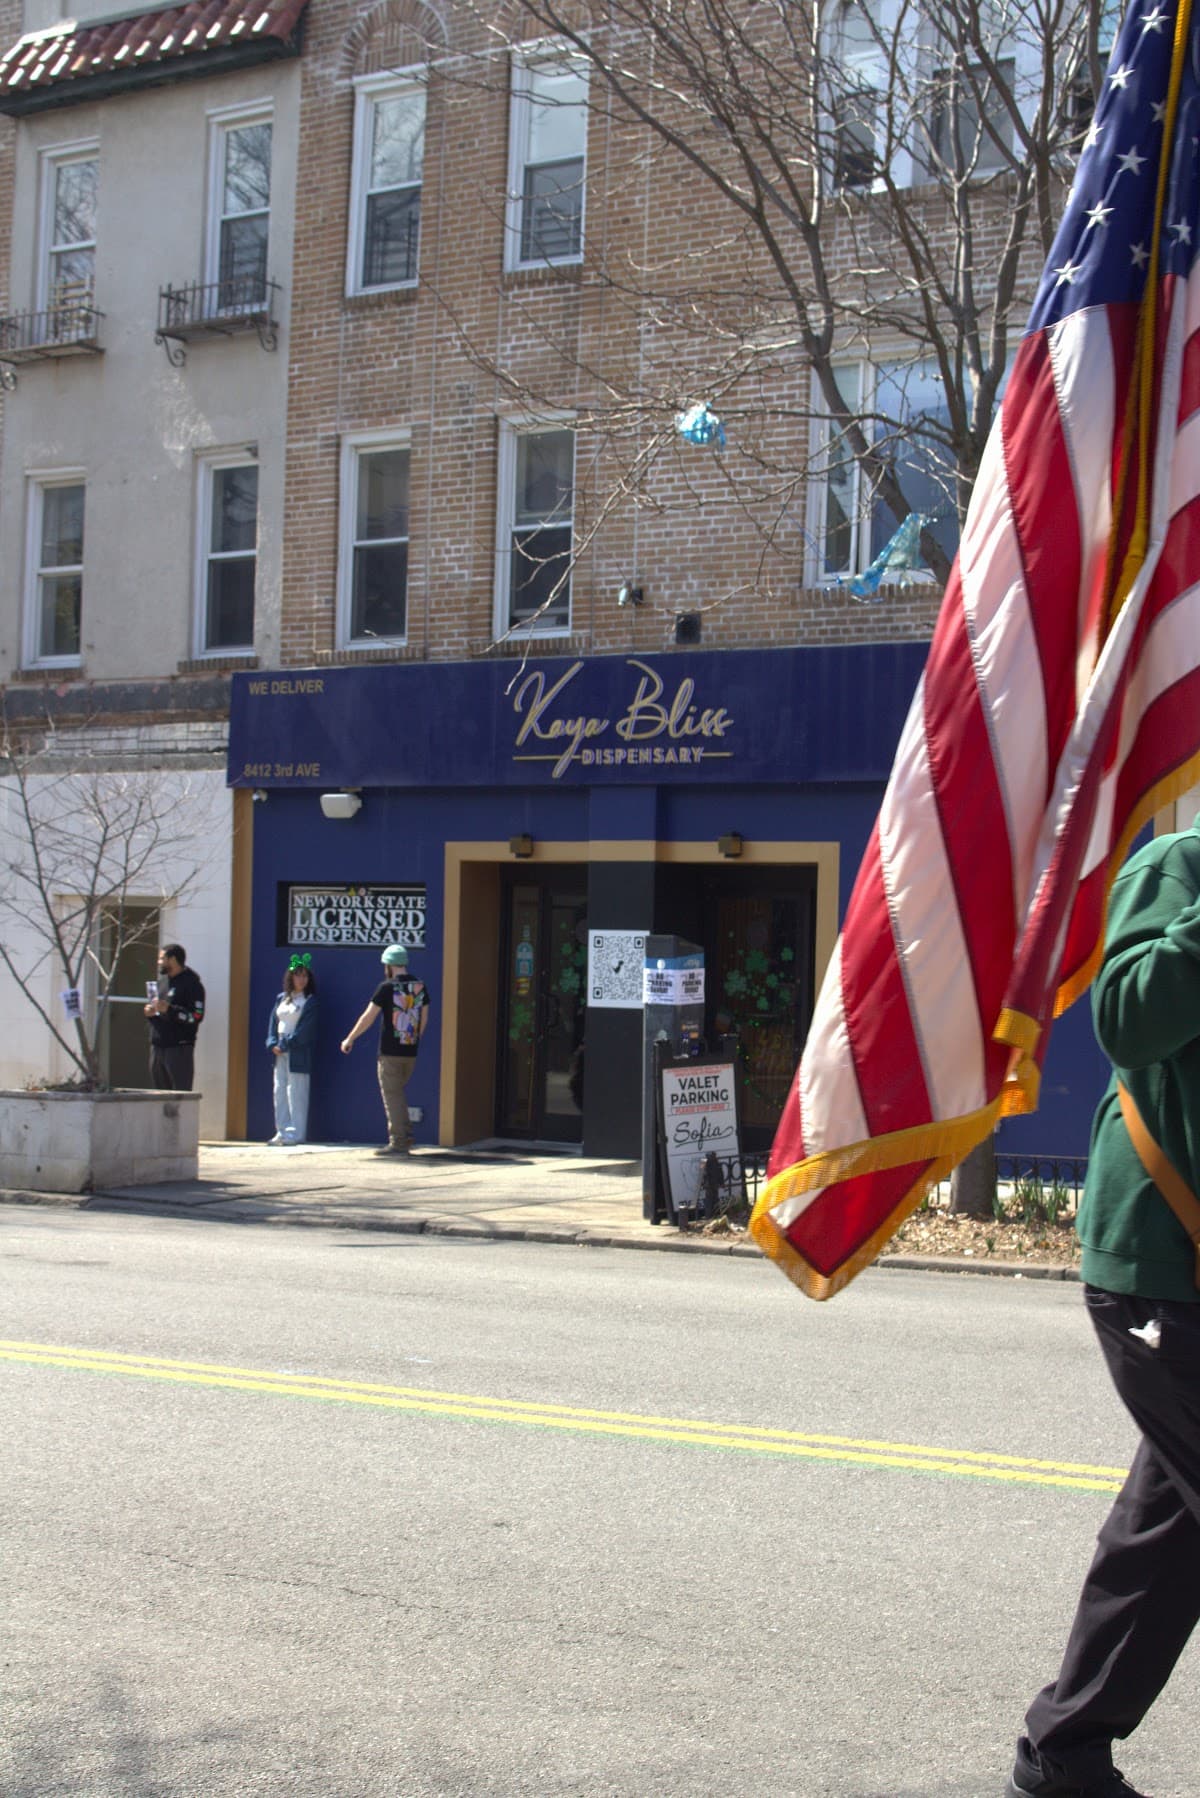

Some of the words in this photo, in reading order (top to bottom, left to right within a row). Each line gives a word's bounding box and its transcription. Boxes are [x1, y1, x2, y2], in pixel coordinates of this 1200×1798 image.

[249, 681, 268, 695] WE
[271, 680, 324, 694] DELIVER
[513, 661, 610, 779] Kaya
[616, 659, 735, 741] Bliss
[581, 747, 704, 765] DISPENSARY
[243, 763, 271, 777] 8412
[274, 763, 293, 777] 3rd
[295, 763, 320, 777] AVE
[293, 895, 330, 908] NEW
[330, 895, 375, 908] YORK
[377, 896, 426, 909] STATE
[293, 908, 425, 930] LICENSED
[292, 927, 425, 944] DISPENSARY
[678, 1075, 720, 1090] VALET
[671, 1089, 729, 1105] PARKING
[673, 1115, 734, 1151] Sofia
